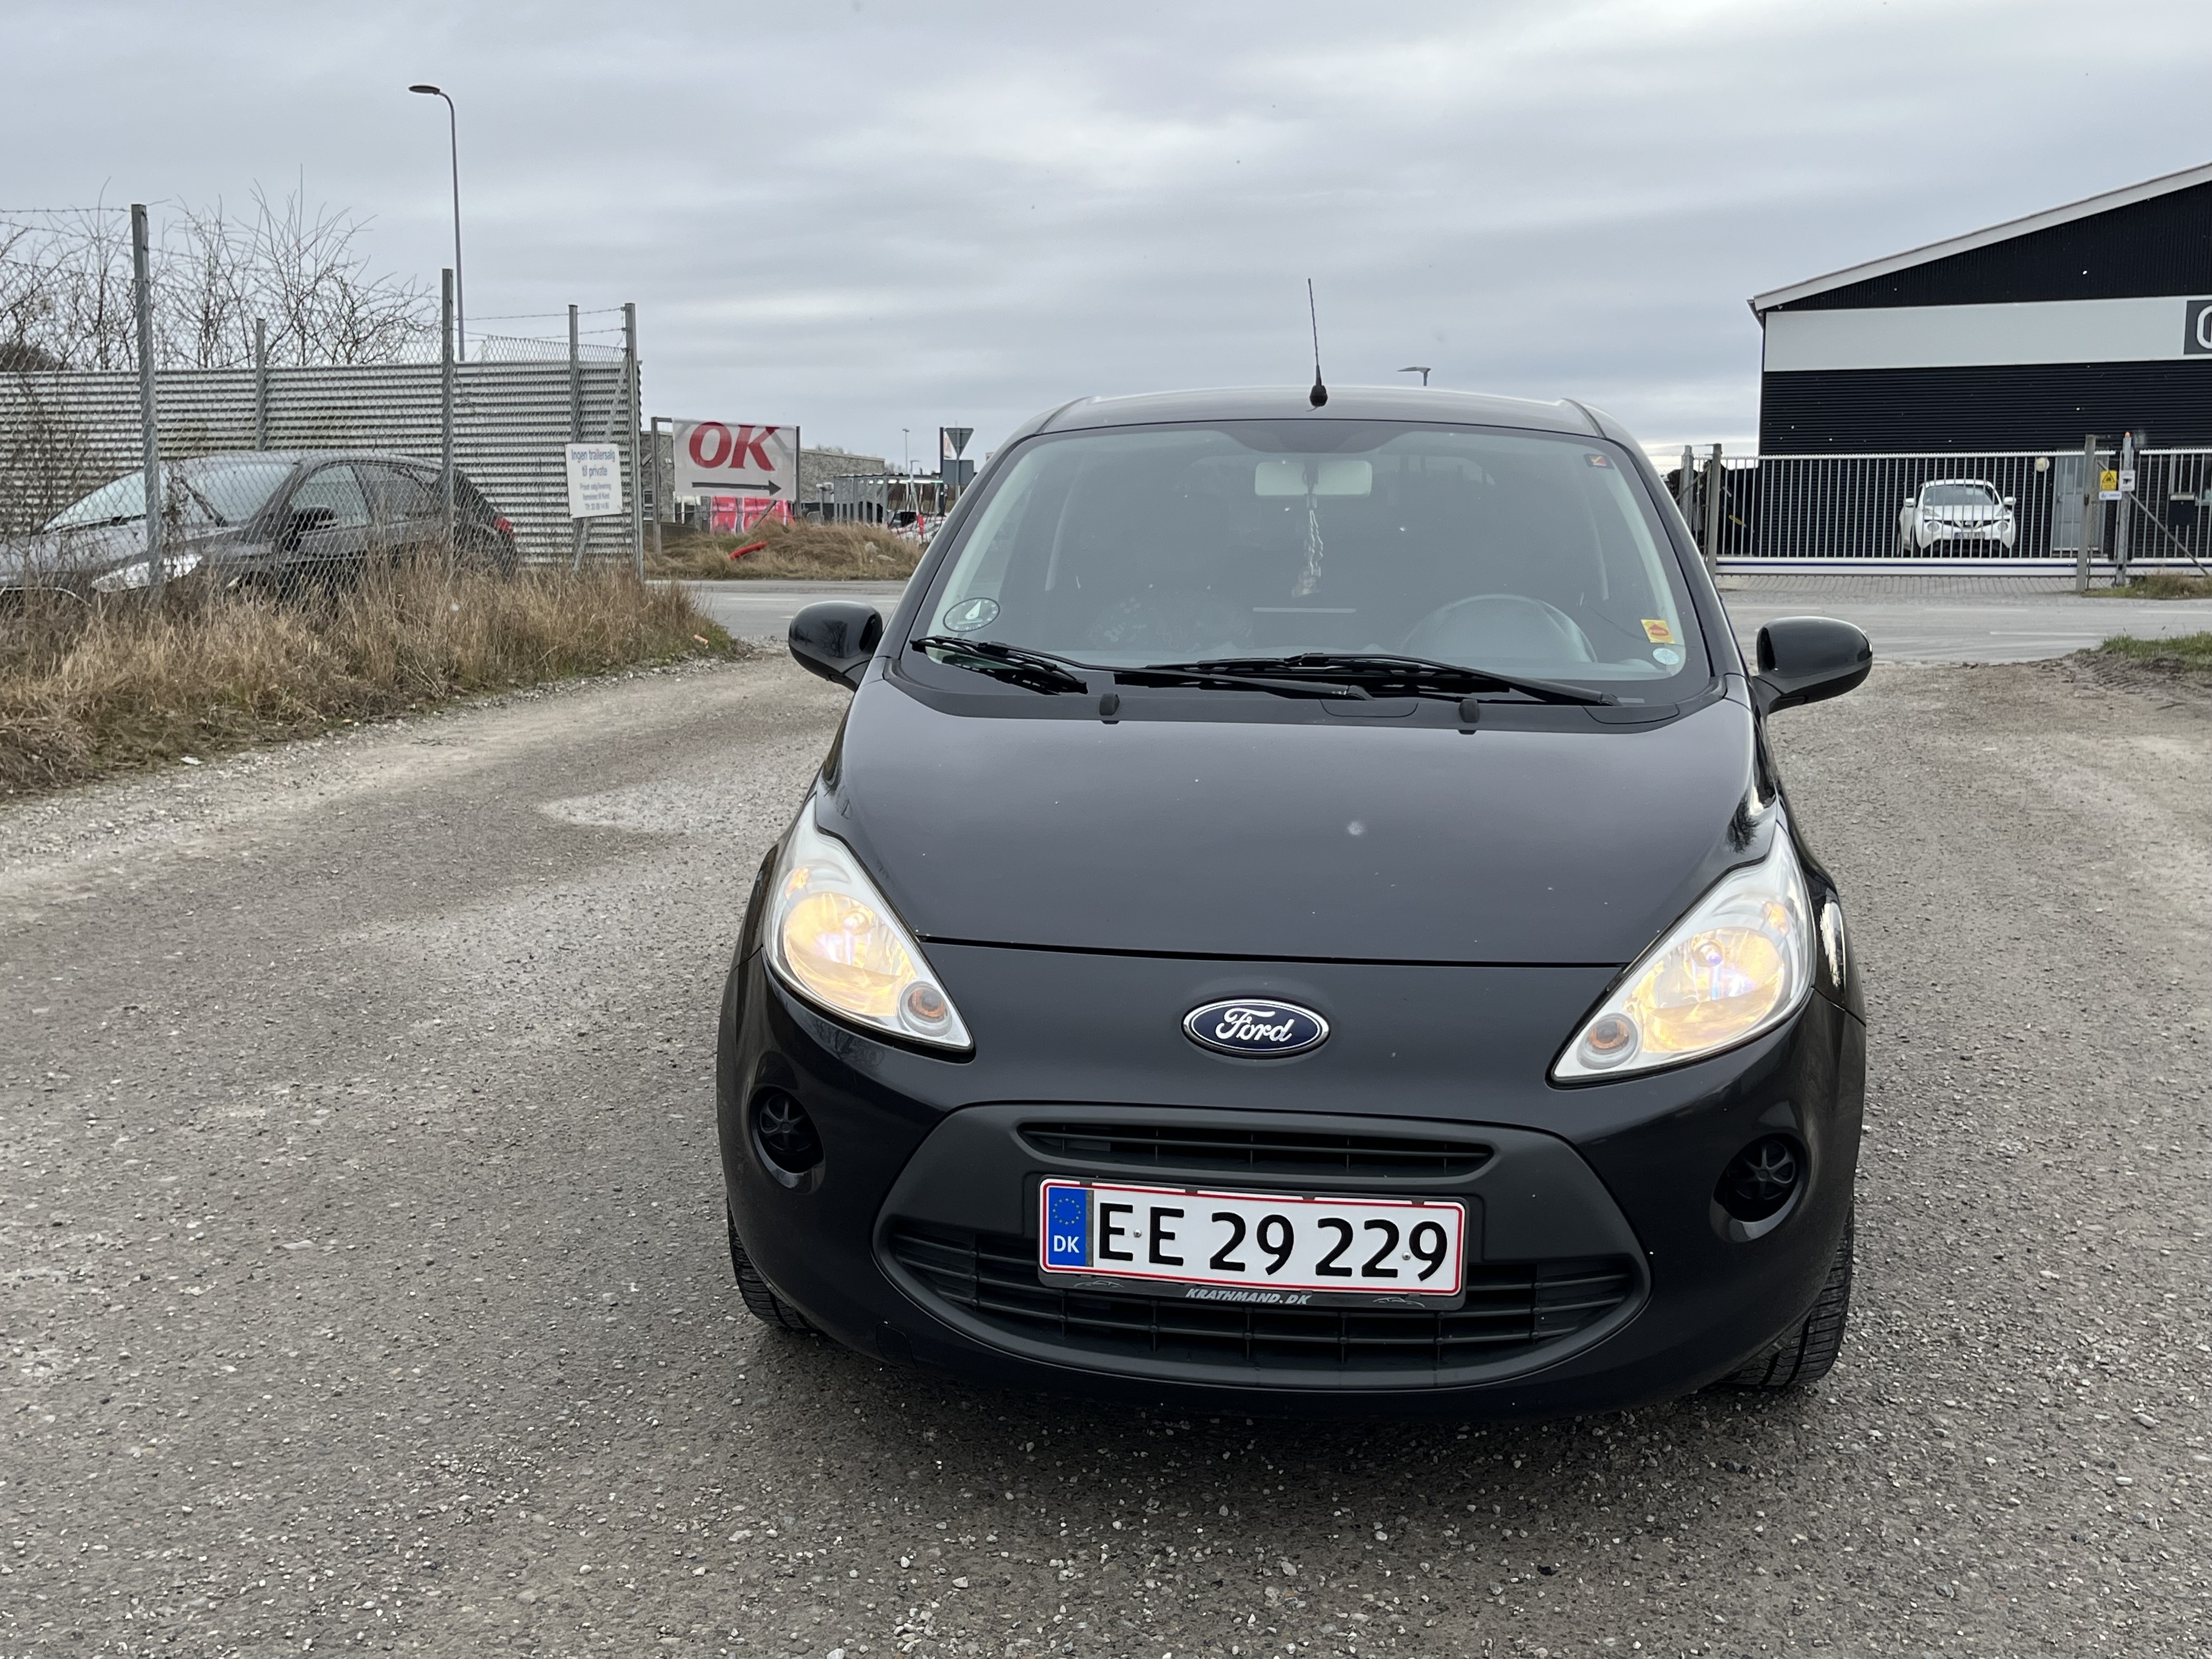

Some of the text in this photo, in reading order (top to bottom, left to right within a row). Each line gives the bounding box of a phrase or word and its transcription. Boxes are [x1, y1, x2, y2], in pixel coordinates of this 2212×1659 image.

[689, 421, 780, 471] OK
[571, 449, 588, 463] Ingen
[589, 465, 608, 479] private
[1215, 1008, 1295, 1042] Ford
[1053, 1235, 1080, 1253] DK
[1099, 1202, 1448, 1282] EE 29 229
[1186, 1288, 1312, 1305] KRATHMAND.DK
